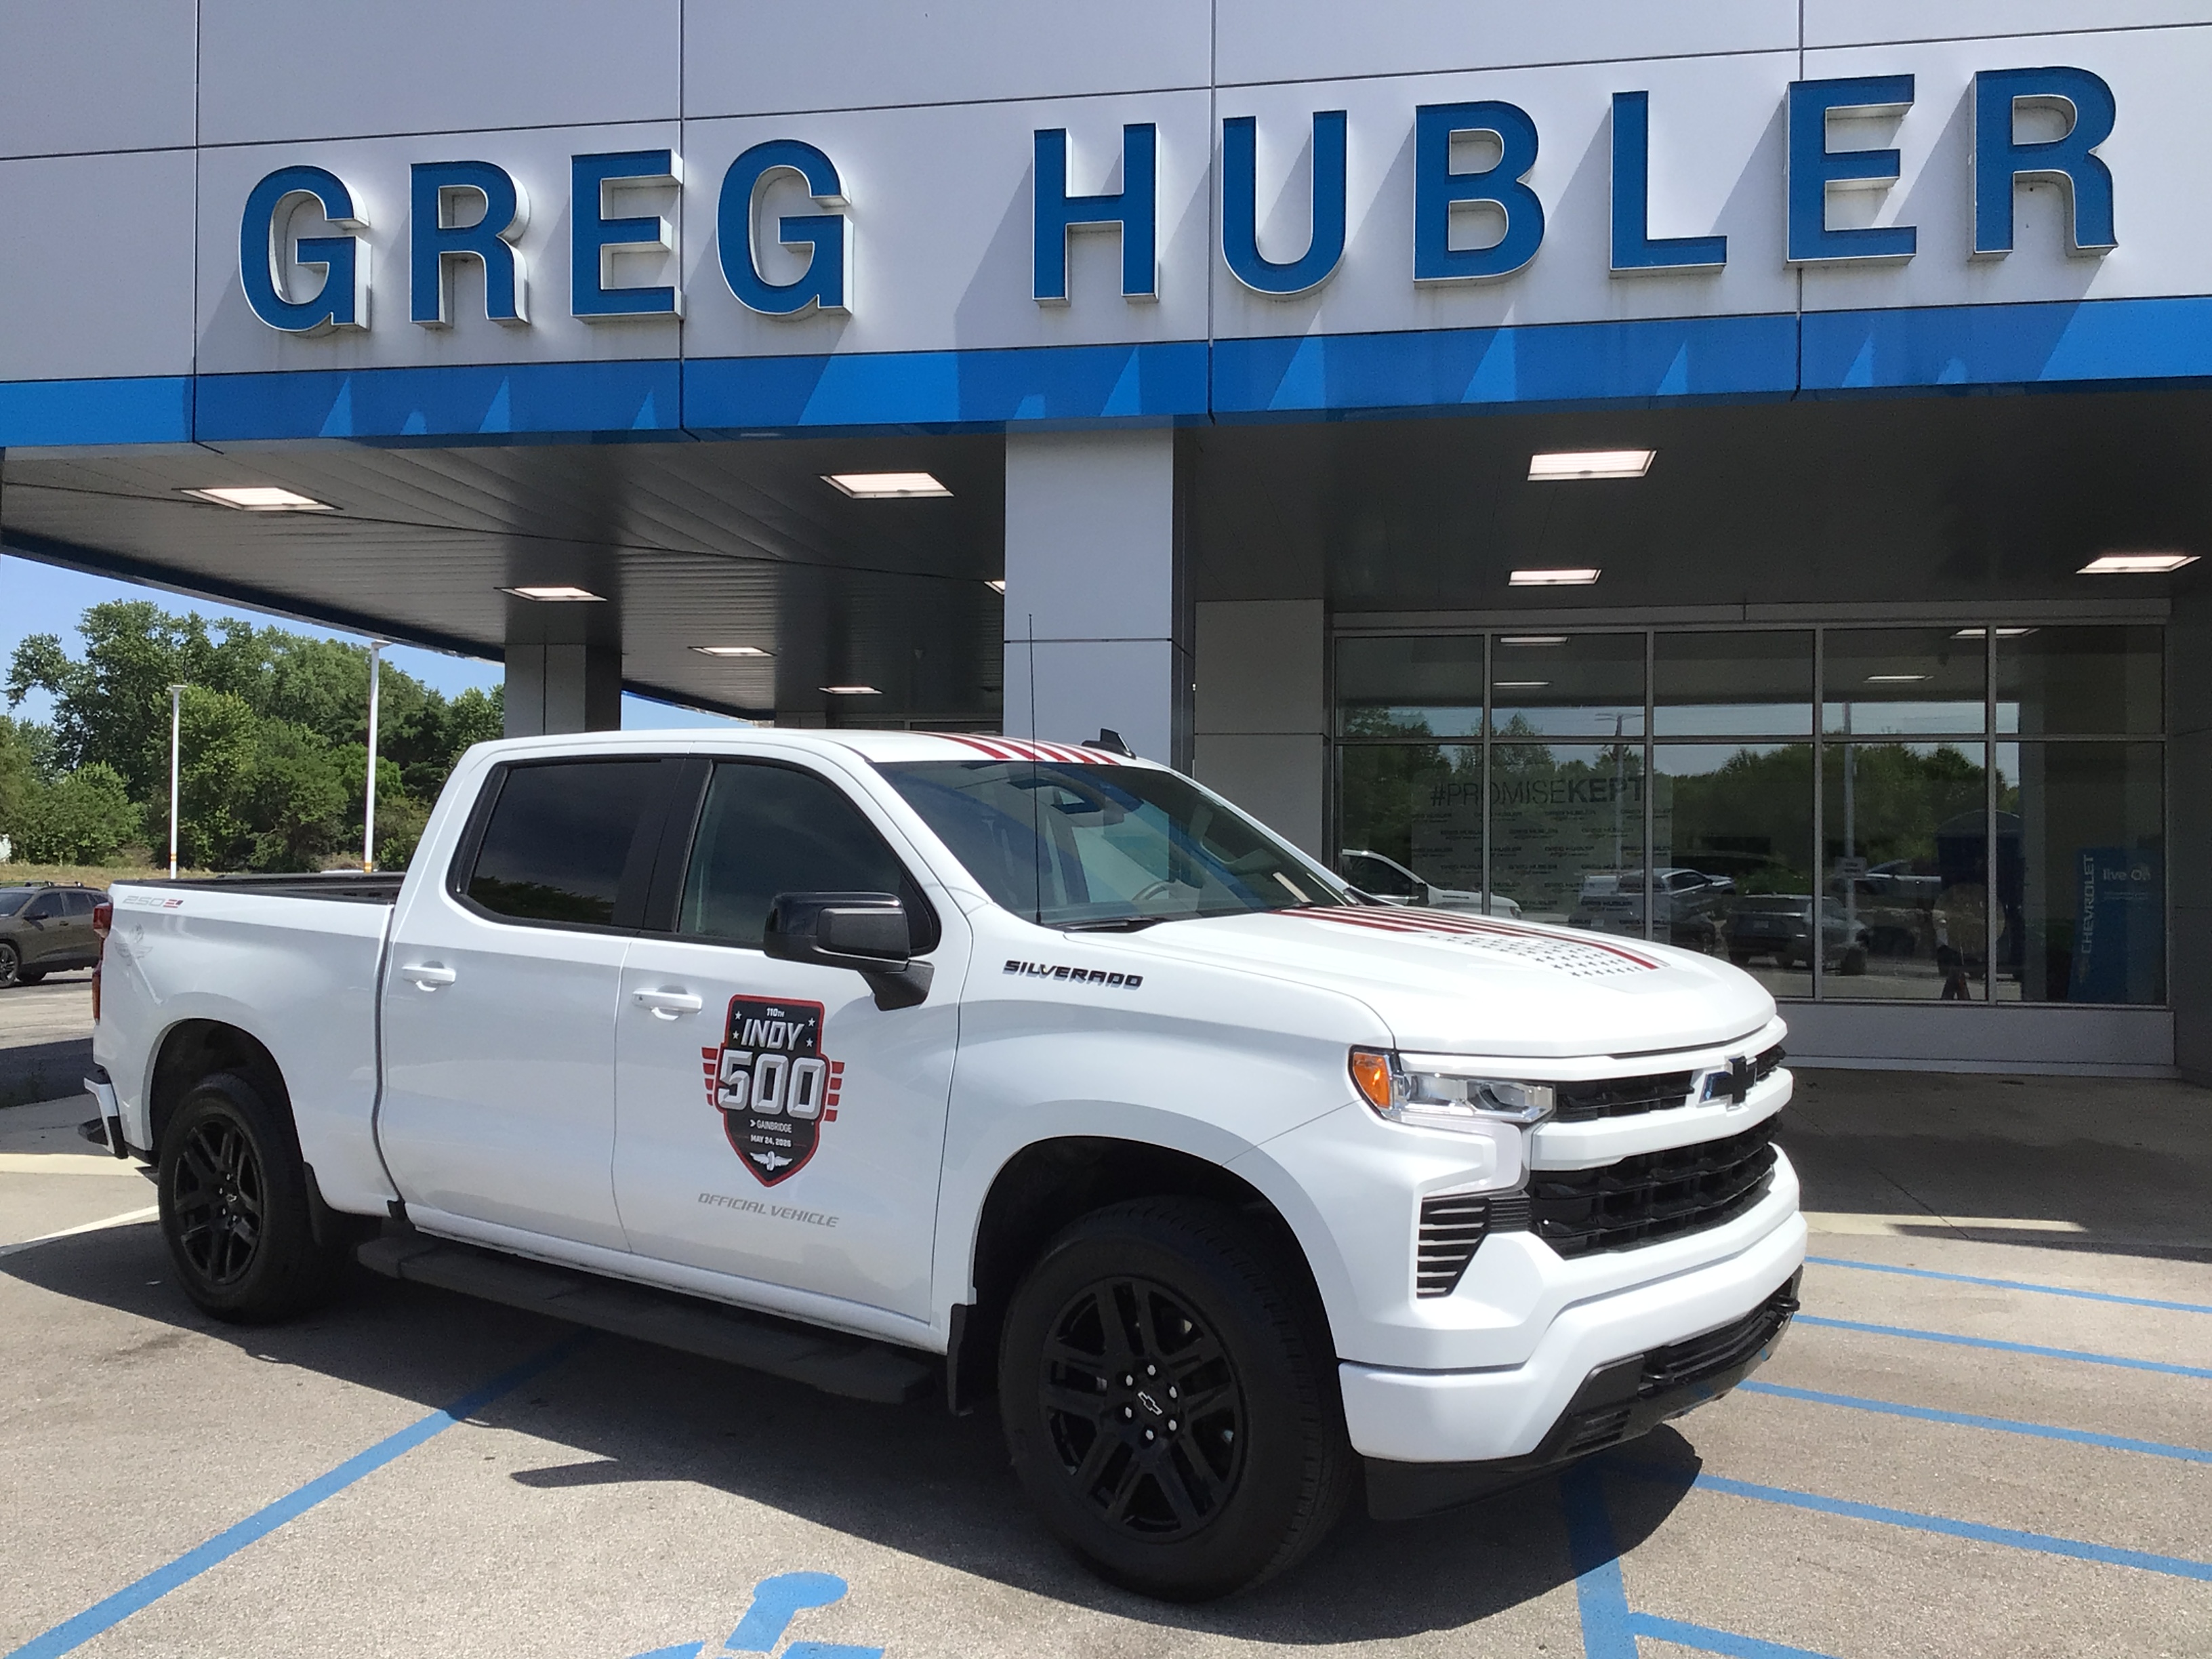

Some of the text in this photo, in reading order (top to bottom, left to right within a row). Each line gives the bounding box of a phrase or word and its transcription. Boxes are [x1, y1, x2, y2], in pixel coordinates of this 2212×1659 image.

[239, 66, 2119, 333] GREG HUBLER
[122, 895, 165, 907] 250
[2081, 854, 2095, 954] CHEVROLET
[1004, 960, 1143, 987] SILVERADO
[741, 1018, 805, 1050] INDY
[717, 1049, 826, 1120] 500
[750, 1134, 764, 1143] MAY
[764, 1136, 775, 1145] 24,
[756, 1120, 792, 1134] GAINBRIDGE
[697, 1192, 840, 1229] OFFICIAL VEHICLE
